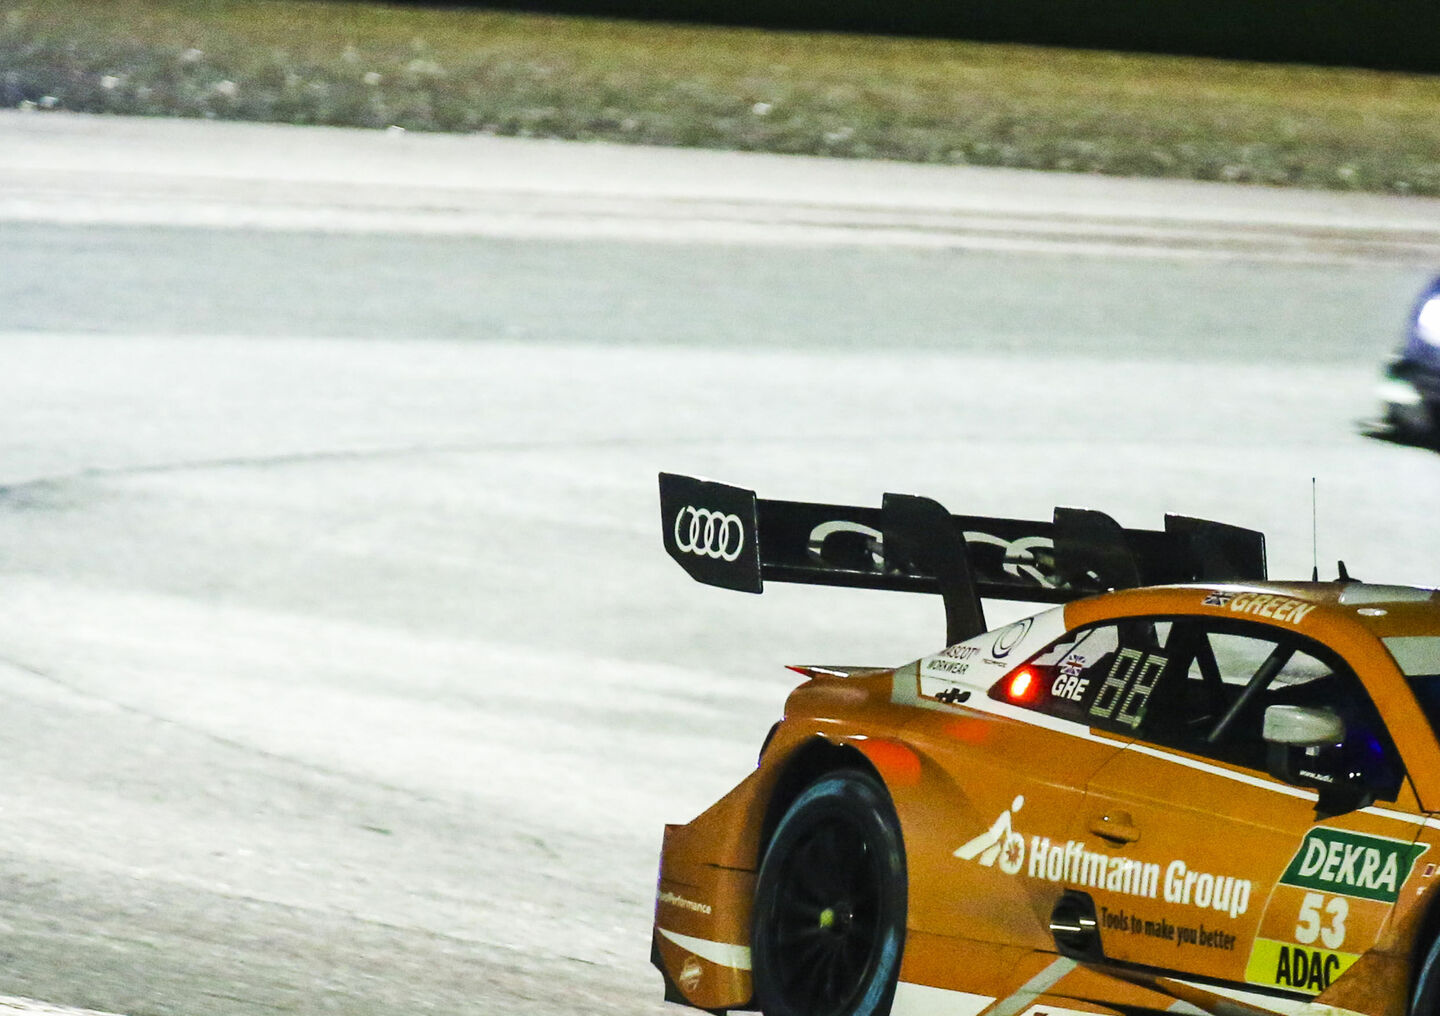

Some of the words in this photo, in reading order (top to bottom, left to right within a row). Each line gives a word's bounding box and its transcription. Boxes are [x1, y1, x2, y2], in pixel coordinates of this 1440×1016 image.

[1229, 592, 1317, 625] GREEN
[1051, 674, 1090, 702] GRE
[1028, 836, 1160, 898] Hoffmann
[1163, 860, 1252, 918] Group
[1298, 837, 1398, 893] DEKRA
[1100, 906, 1129, 931] Tools
[1131, 914, 1142, 934] to
[1144, 918, 1174, 941] make
[1176, 926, 1197, 947] you
[1199, 923, 1237, 950] better
[1295, 892, 1349, 949] 53
[1274, 946, 1340, 991] ADAC
